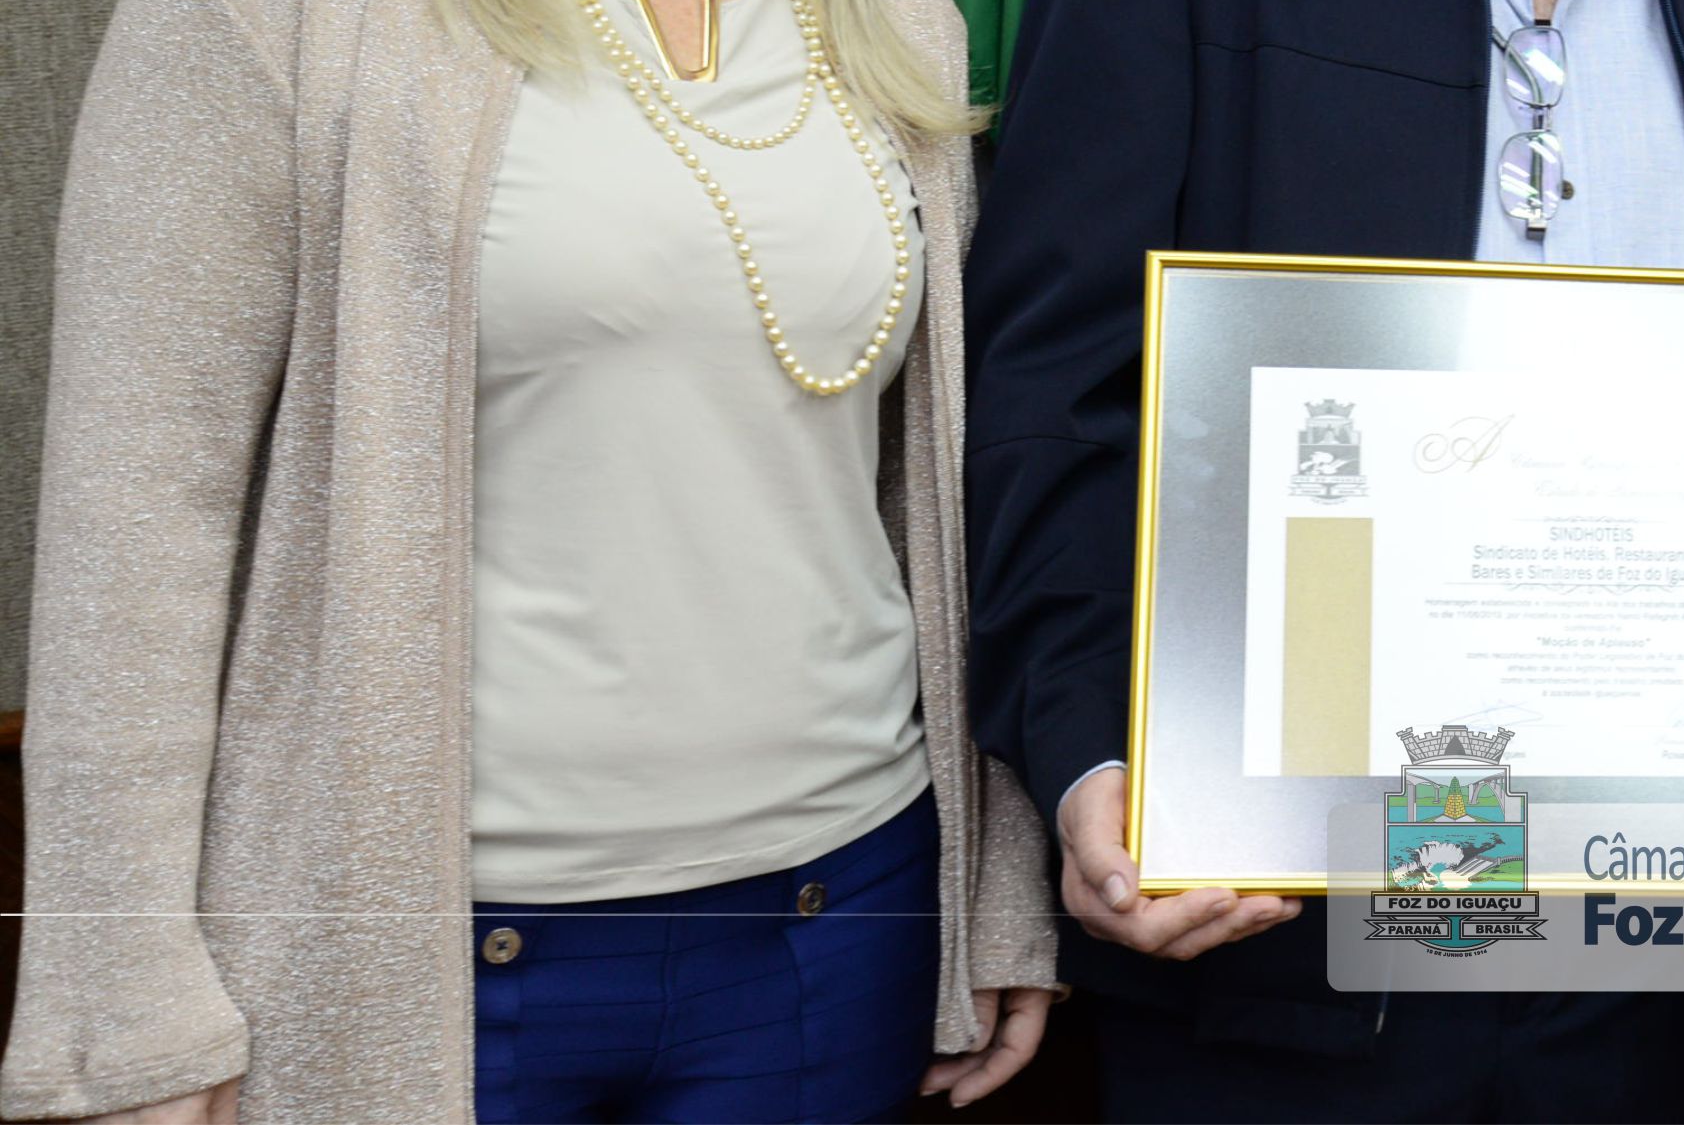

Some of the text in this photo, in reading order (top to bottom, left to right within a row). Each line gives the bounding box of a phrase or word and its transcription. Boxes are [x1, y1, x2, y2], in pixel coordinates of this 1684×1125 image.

[1473, 544, 1537, 561] Sindicato
[1542, 546, 1558, 561] de
[1471, 563, 1511, 579] Bares
[1515, 567, 1524, 579] e
[1528, 564, 1593, 580] Similares
[1596, 566, 1613, 581] de
[1617, 566, 1640, 581] Foz
[1644, 567, 1662, 581] do
[1582, 638, 1595, 648] de
